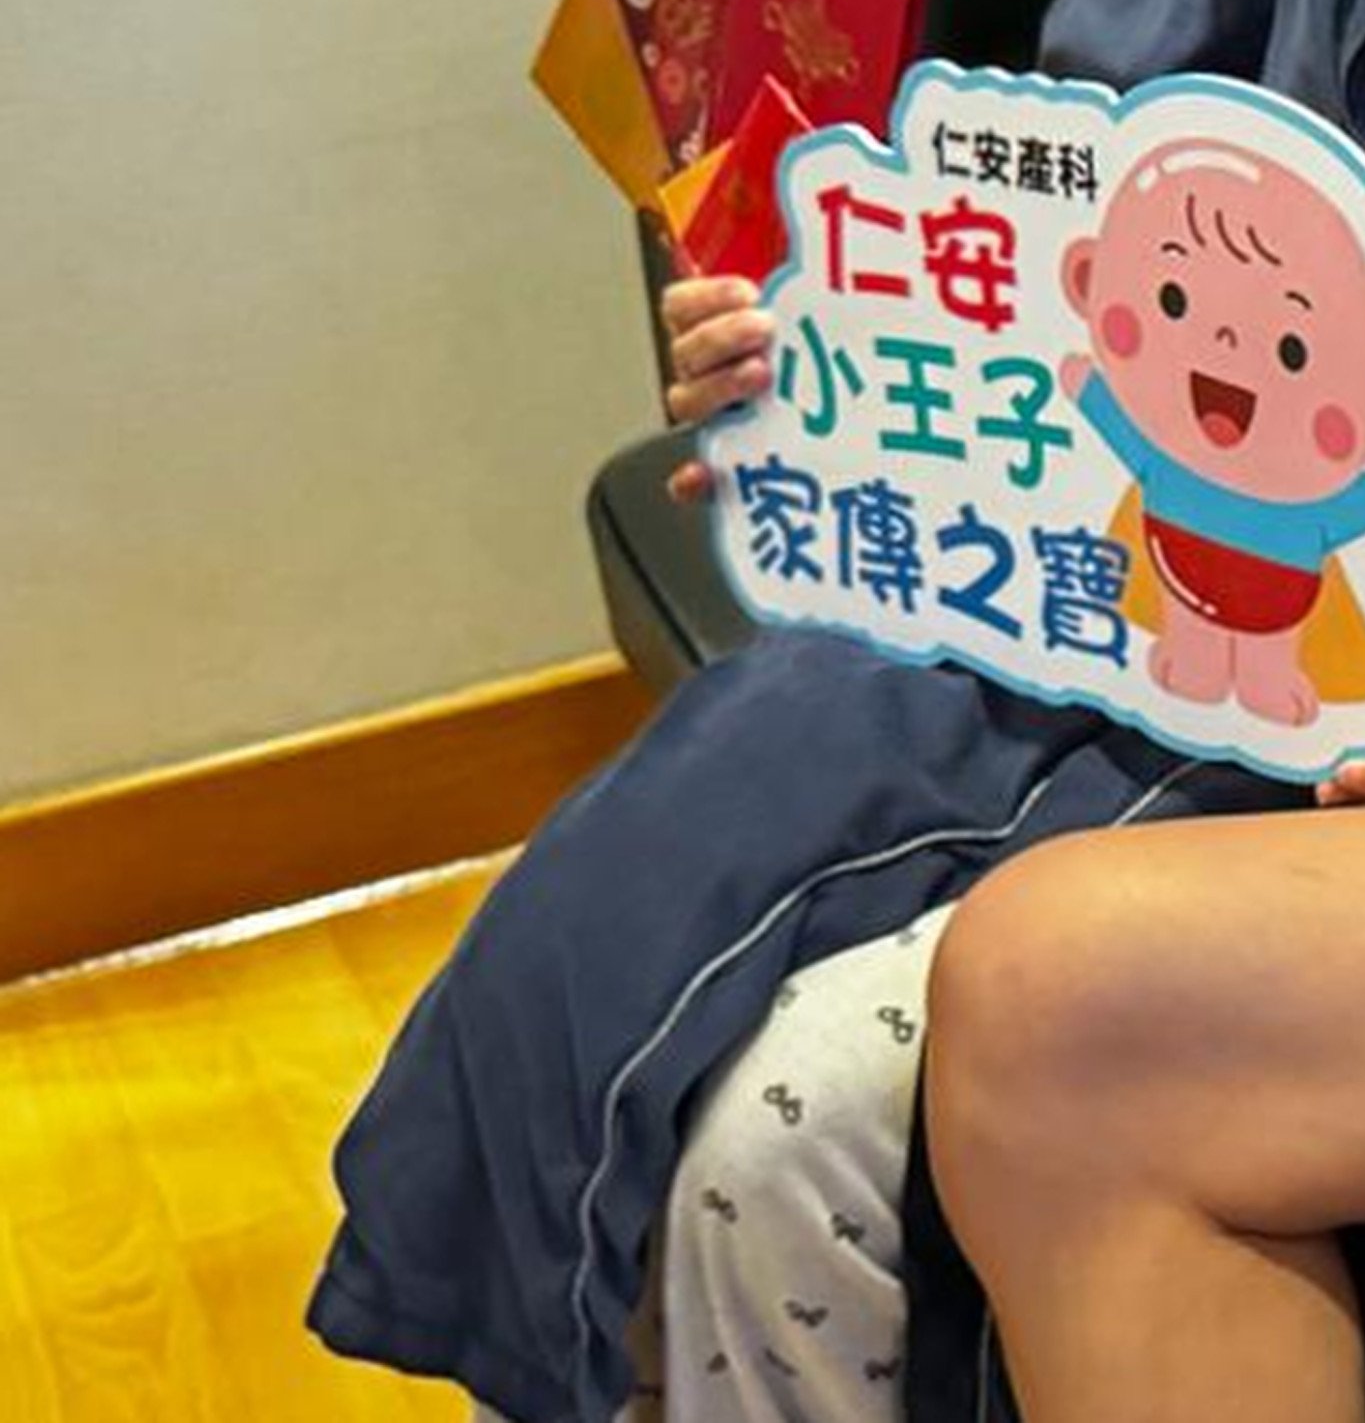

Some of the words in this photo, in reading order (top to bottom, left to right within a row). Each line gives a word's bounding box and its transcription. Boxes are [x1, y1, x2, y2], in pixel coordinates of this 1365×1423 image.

[931, 120, 1099, 201] 仁安產科
[817, 185, 1018, 332] 仁安
[779, 316, 1074, 490] 小王子
[736, 455, 1130, 668] 家傳之寶
